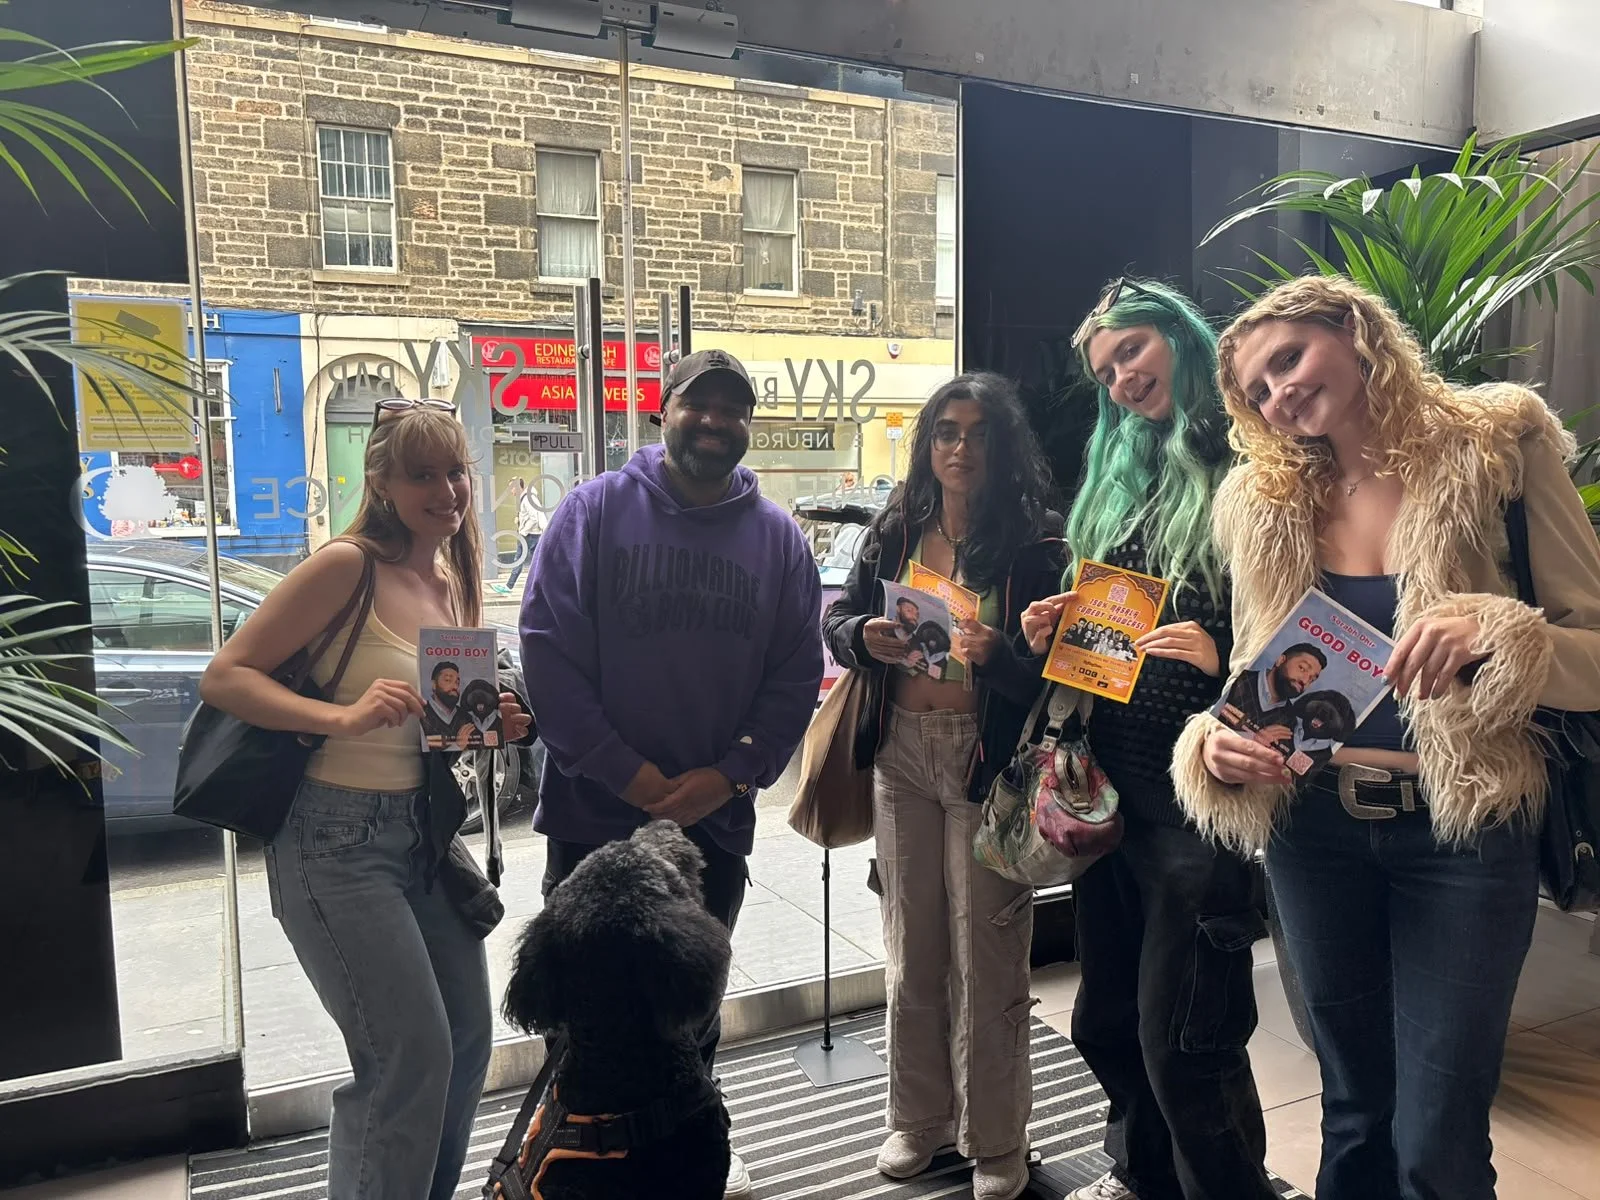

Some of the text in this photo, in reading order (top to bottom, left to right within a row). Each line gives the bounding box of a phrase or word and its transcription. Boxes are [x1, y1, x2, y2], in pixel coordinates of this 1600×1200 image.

[534, 343, 616, 359] EDINBGH
[536, 356, 616, 367] RESTAURA AFE
[541, 386, 645, 402] ASIA WEES
[538, 435, 574, 449] PULL
[1076, 605, 1145, 630] COMEDY SHOWCASE
[1110, 604, 1139, 619] MASALA
[425, 647, 489, 657] GOOD BOY
[1299, 617, 1384, 677] GOOD BOY
